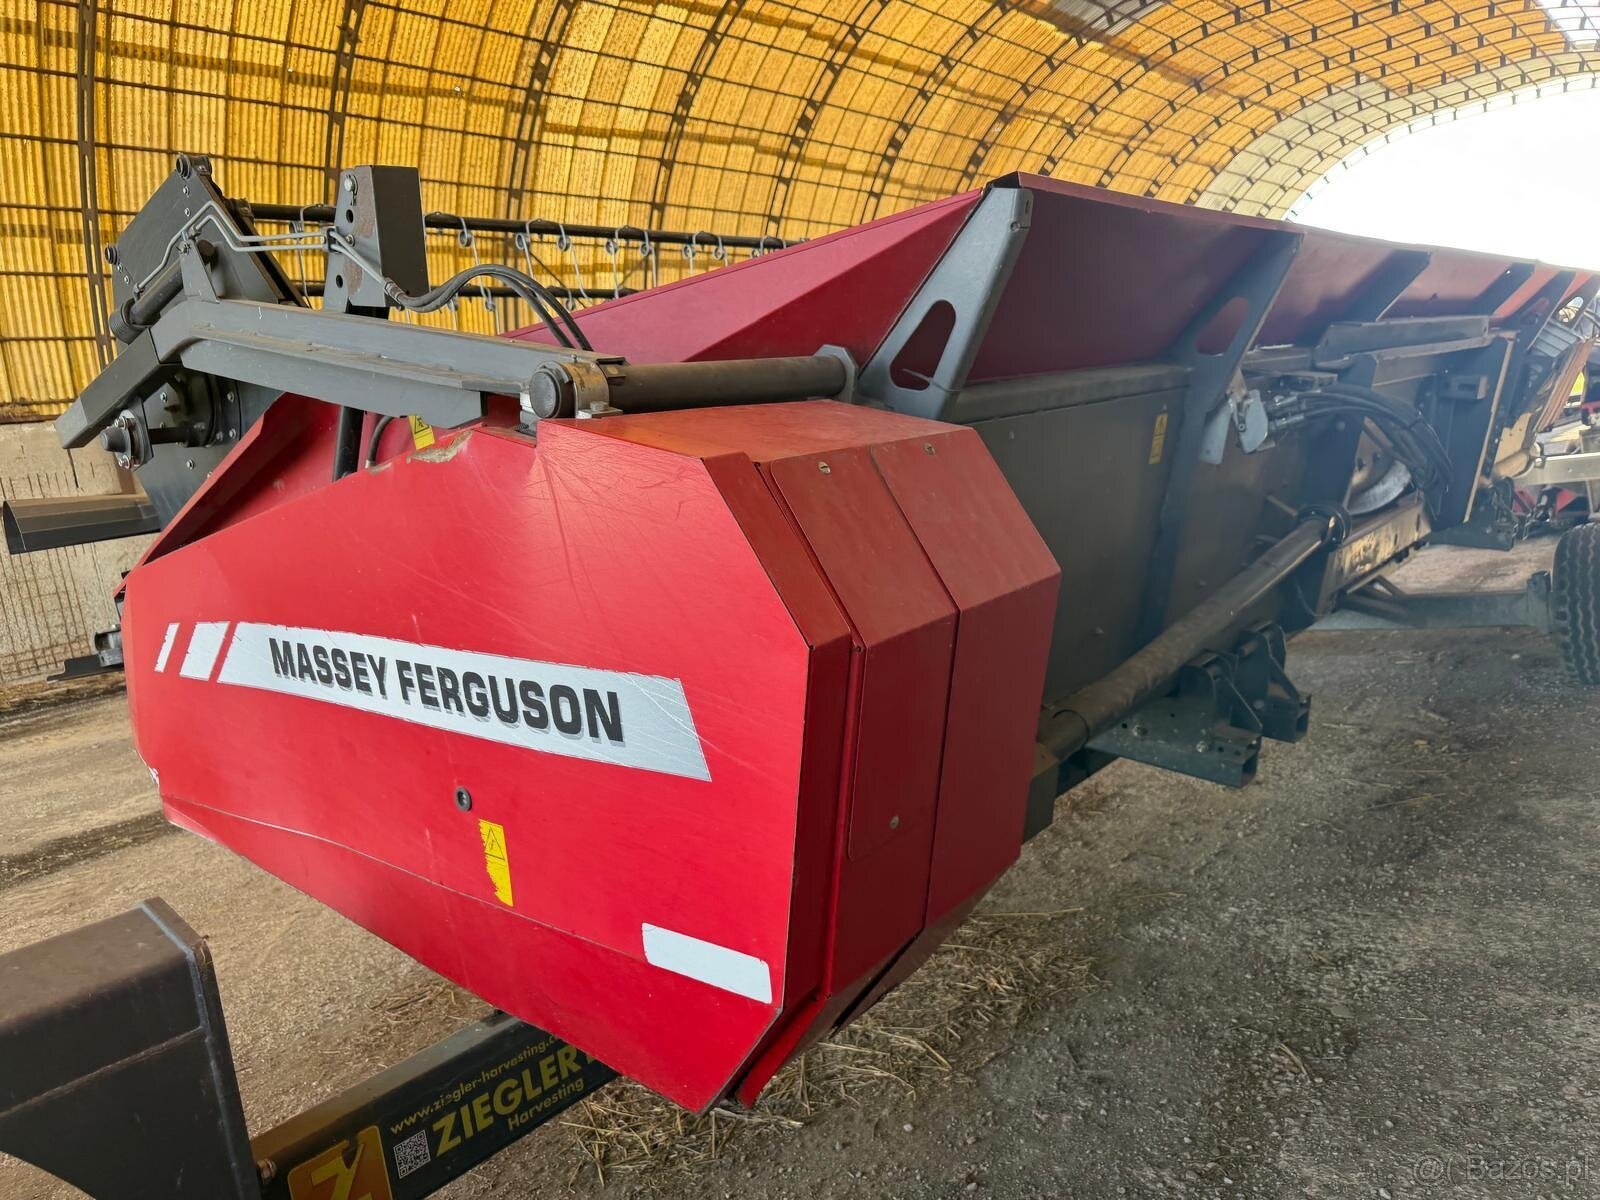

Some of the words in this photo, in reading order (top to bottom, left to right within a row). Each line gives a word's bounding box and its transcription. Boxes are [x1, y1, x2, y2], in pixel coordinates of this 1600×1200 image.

[269, 638, 388, 700] MASSEY
[395, 659, 626, 747] FERGUSON
[390, 1034, 559, 1135] www.ziegler-harvesting.c
[432, 1045, 582, 1157] ZIEGLER
[507, 1077, 585, 1131] Harvesting
